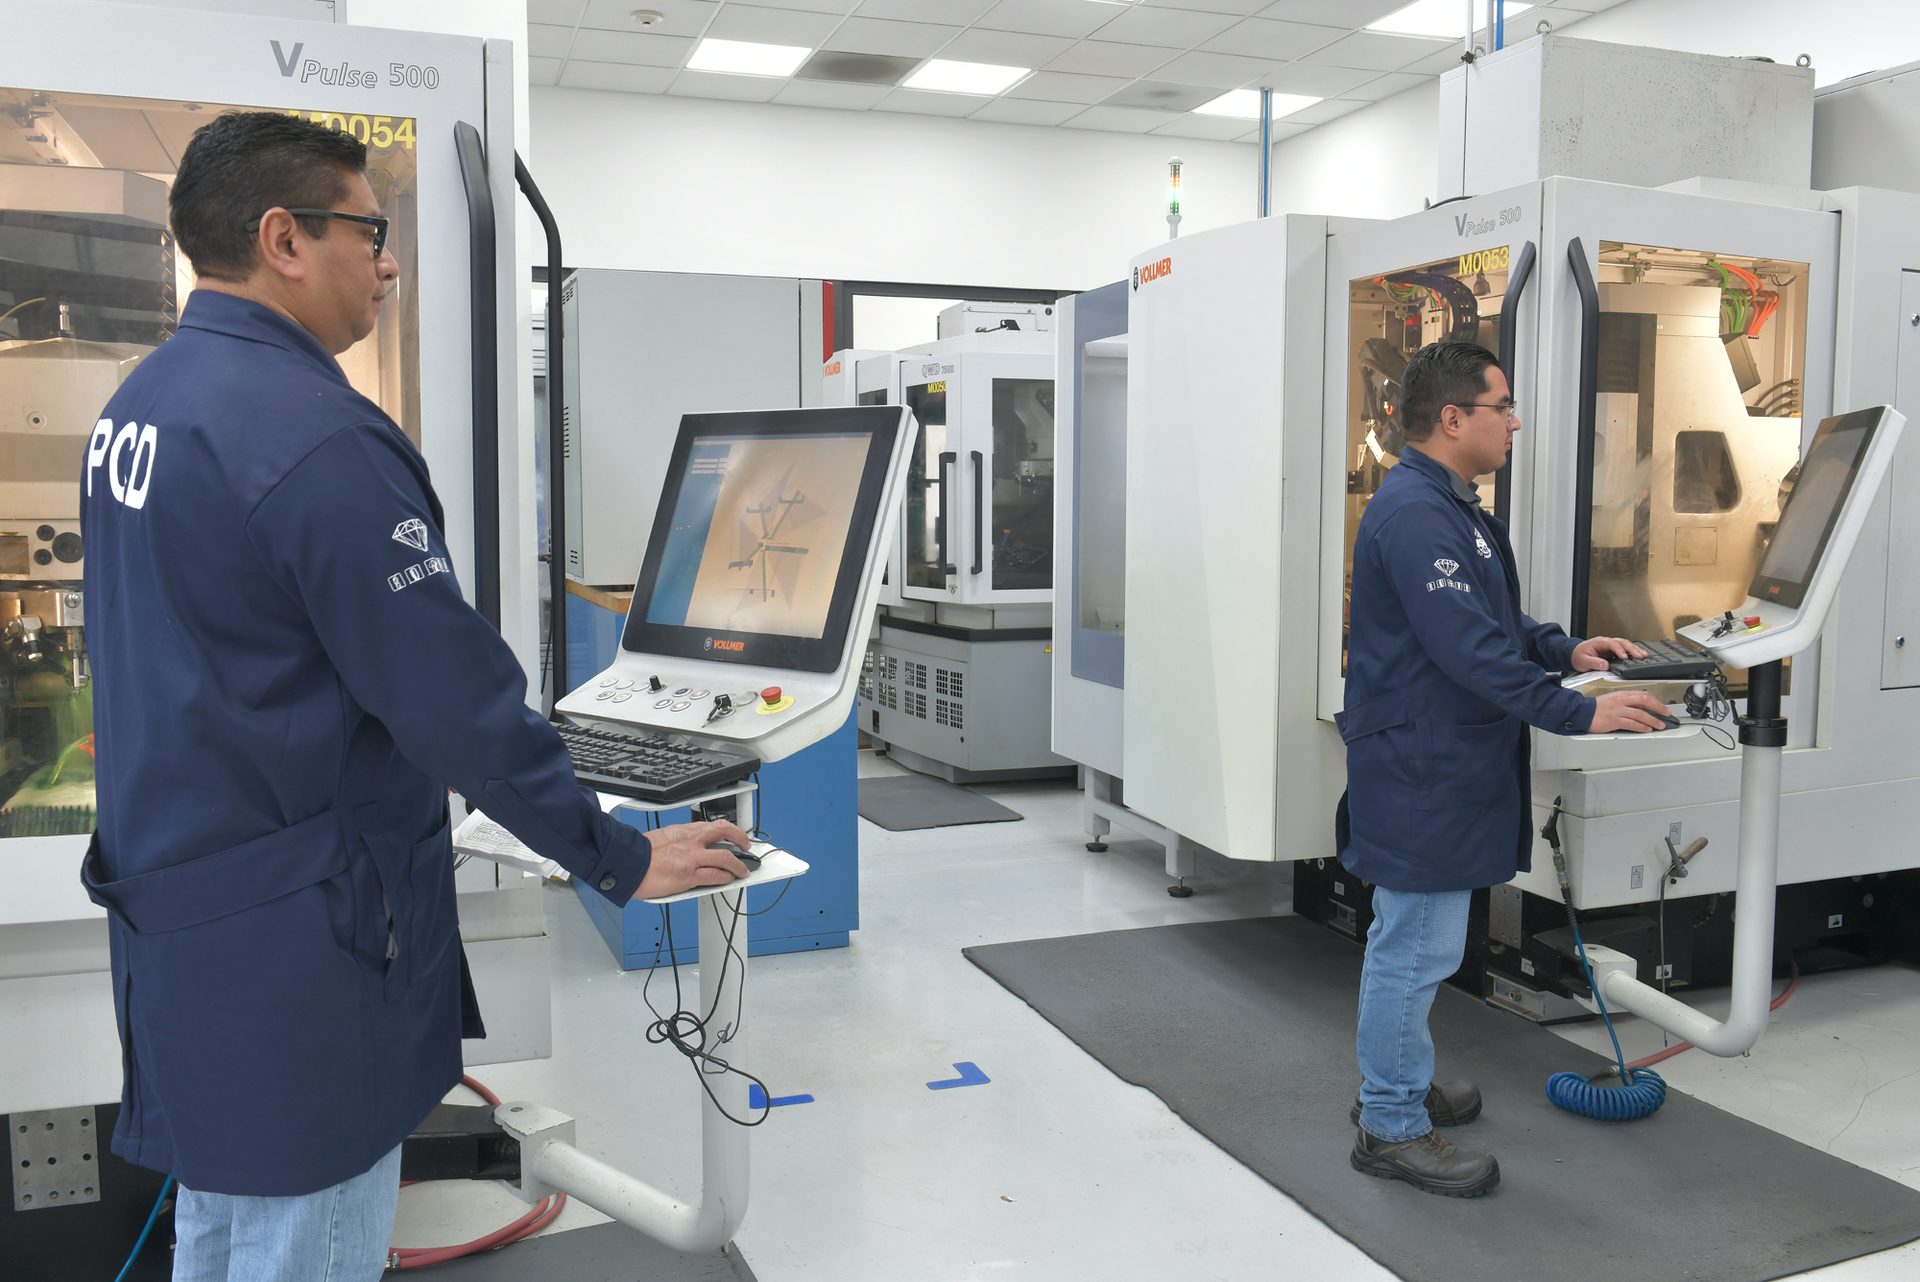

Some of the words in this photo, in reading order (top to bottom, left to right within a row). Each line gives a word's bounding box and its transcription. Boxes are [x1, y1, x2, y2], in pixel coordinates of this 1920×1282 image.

[389, 63, 440, 90] 500
[1499, 205, 1522, 227] 500
[1139, 256, 1172, 285] VOLLMER
[1459, 246, 1509, 276] M0053
[87, 418, 158, 510] PCD
[713, 639, 745, 652] VOLLMER
